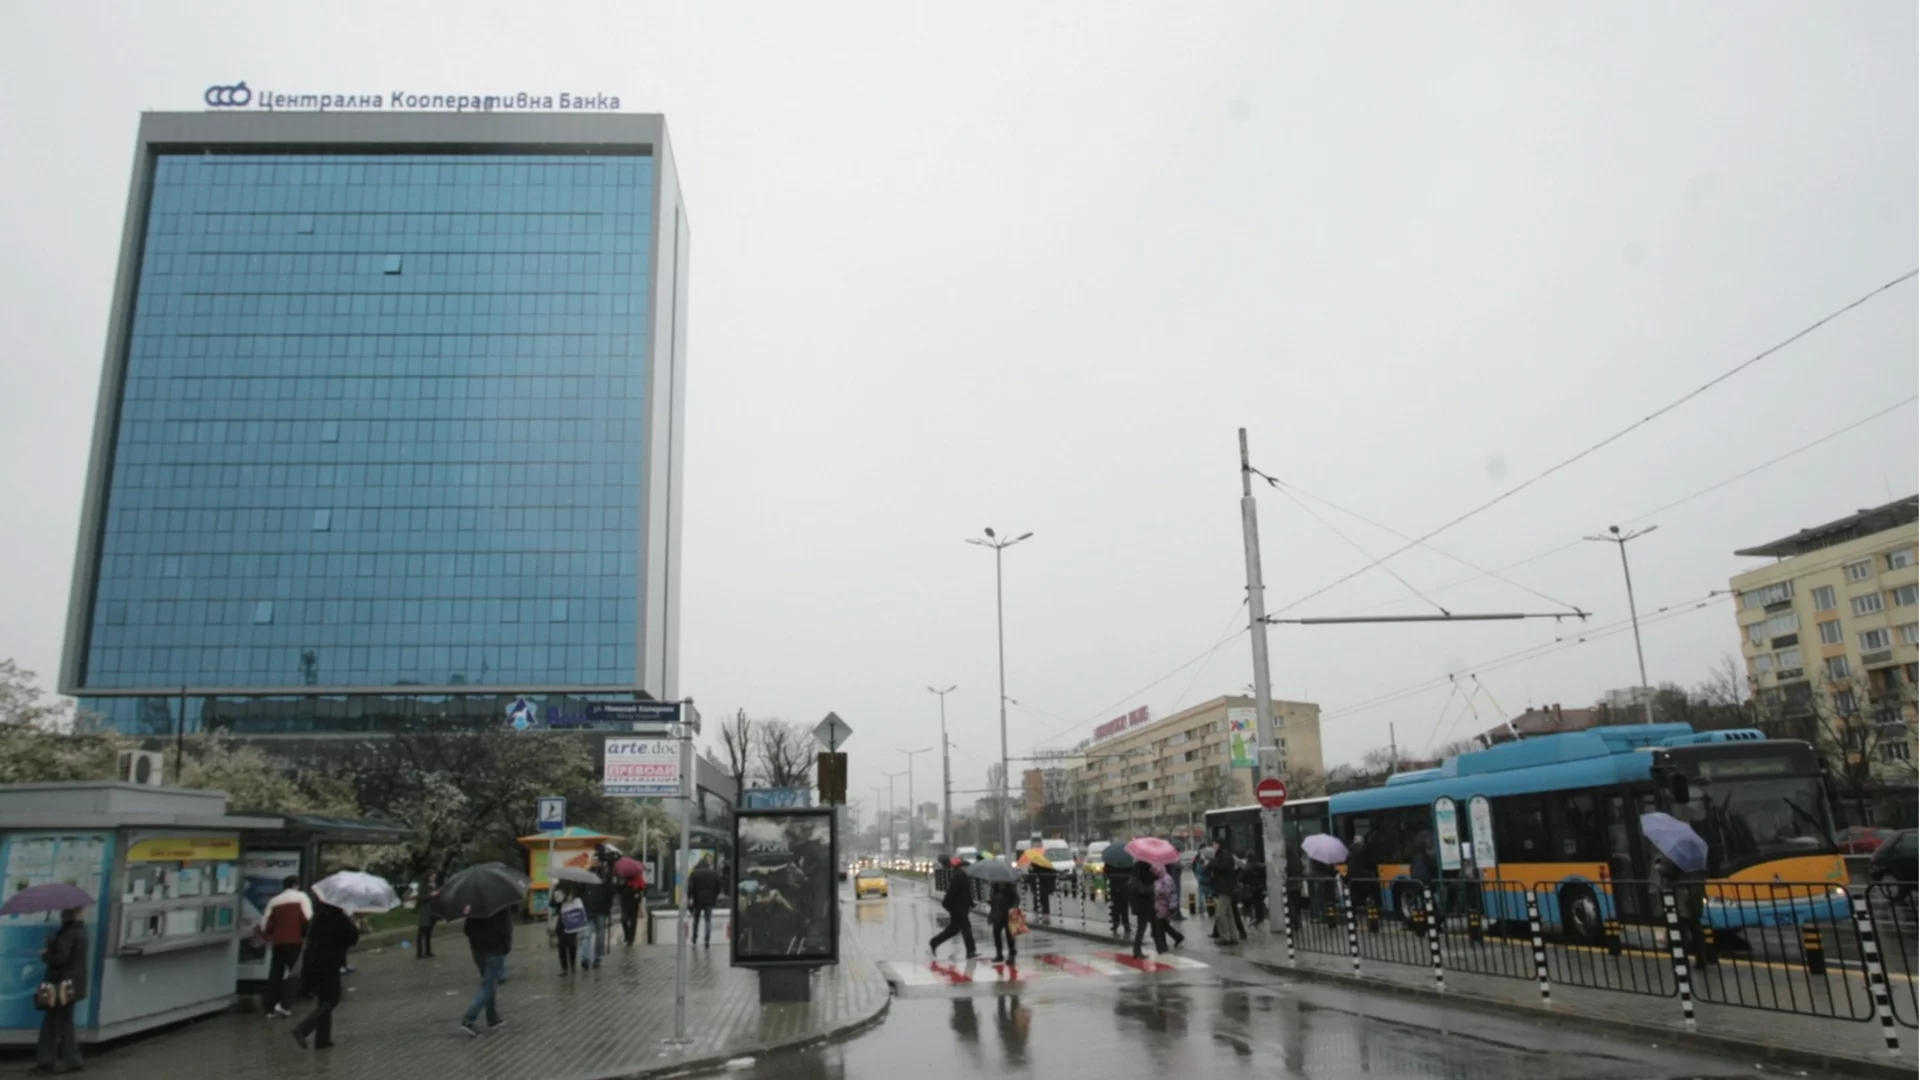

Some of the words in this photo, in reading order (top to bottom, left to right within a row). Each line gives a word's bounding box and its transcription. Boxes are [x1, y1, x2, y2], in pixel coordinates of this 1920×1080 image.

[258, 91, 384, 112] Централна
[391, 91, 553, 113] Кооперативна
[559, 92, 620, 110] Банка
